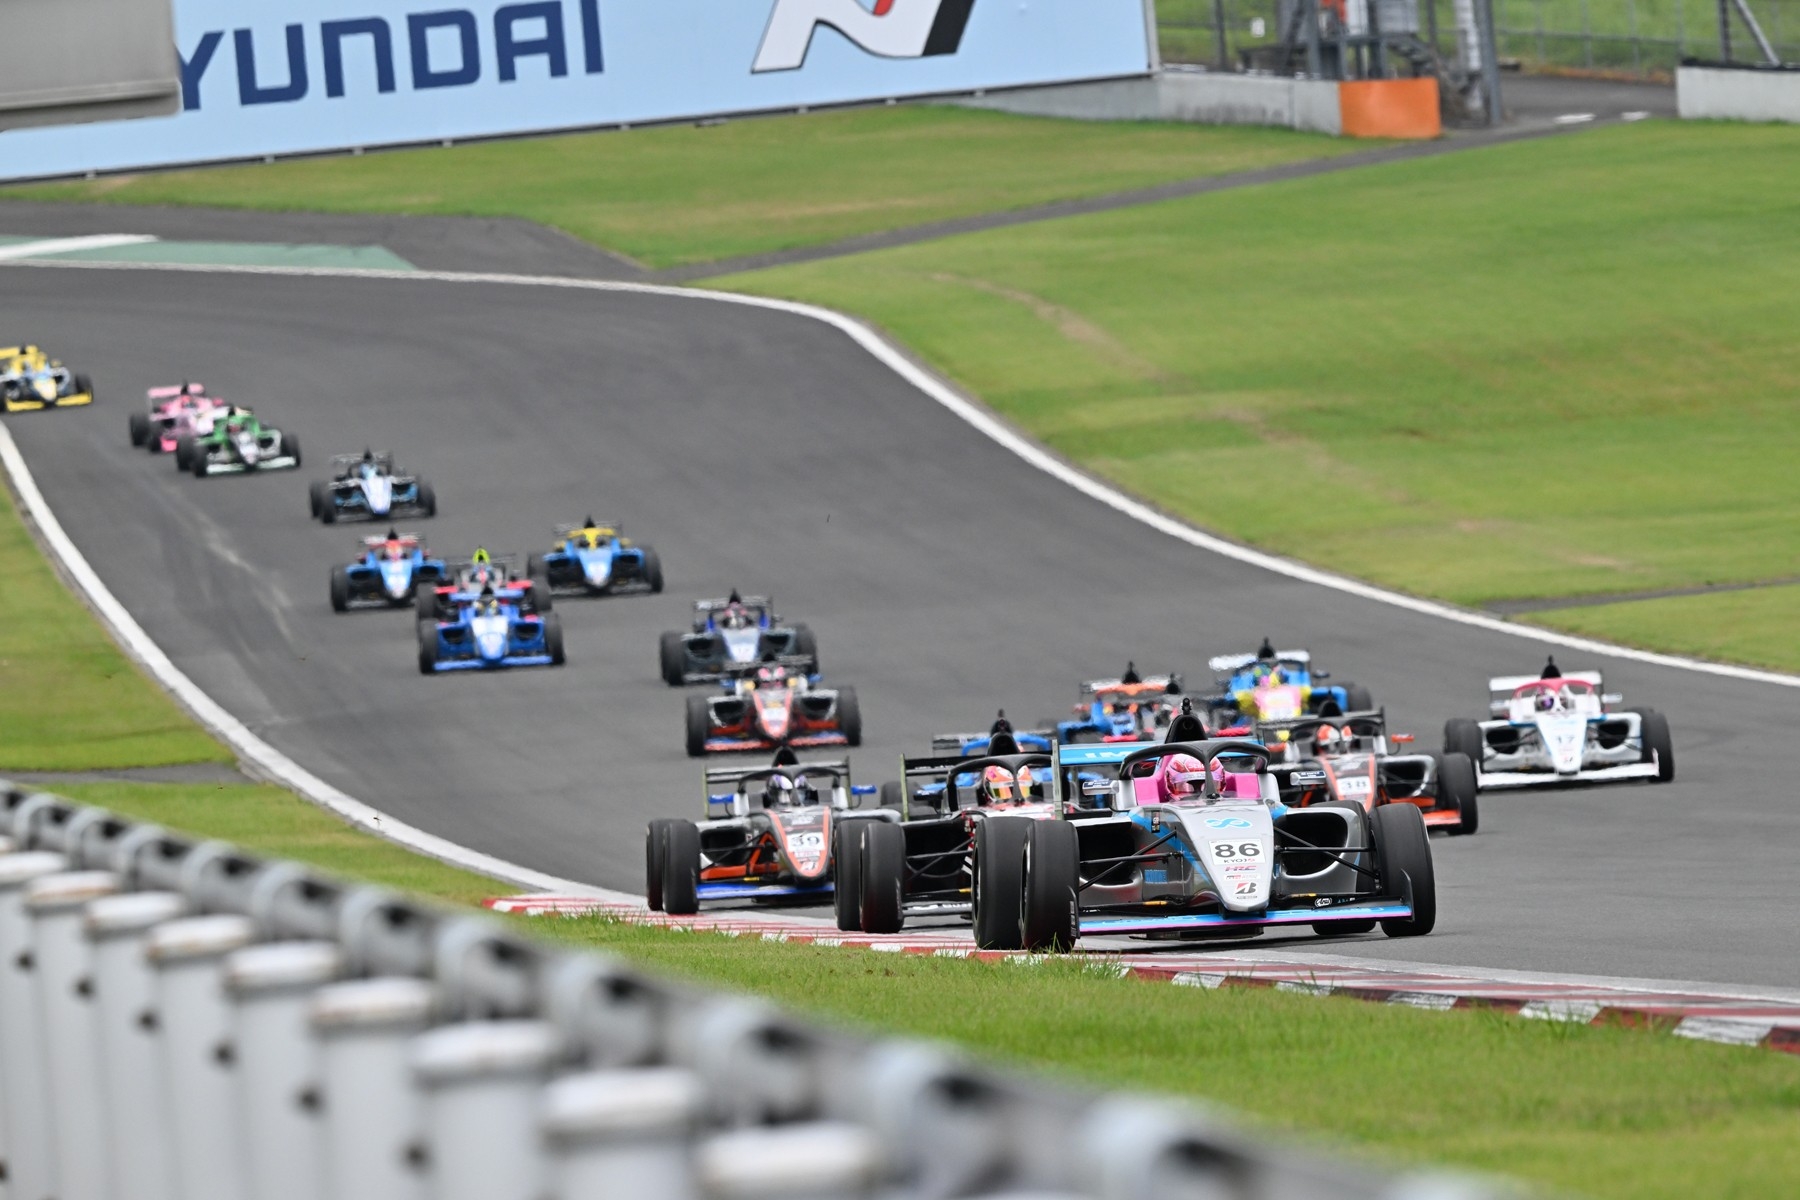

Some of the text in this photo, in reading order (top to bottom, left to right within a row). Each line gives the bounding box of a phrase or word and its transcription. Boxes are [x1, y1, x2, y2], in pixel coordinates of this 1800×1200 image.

[175, 0, 604, 111] YUNDAI
[790, 835, 820, 847] 39
[1215, 843, 1260, 858] 86
